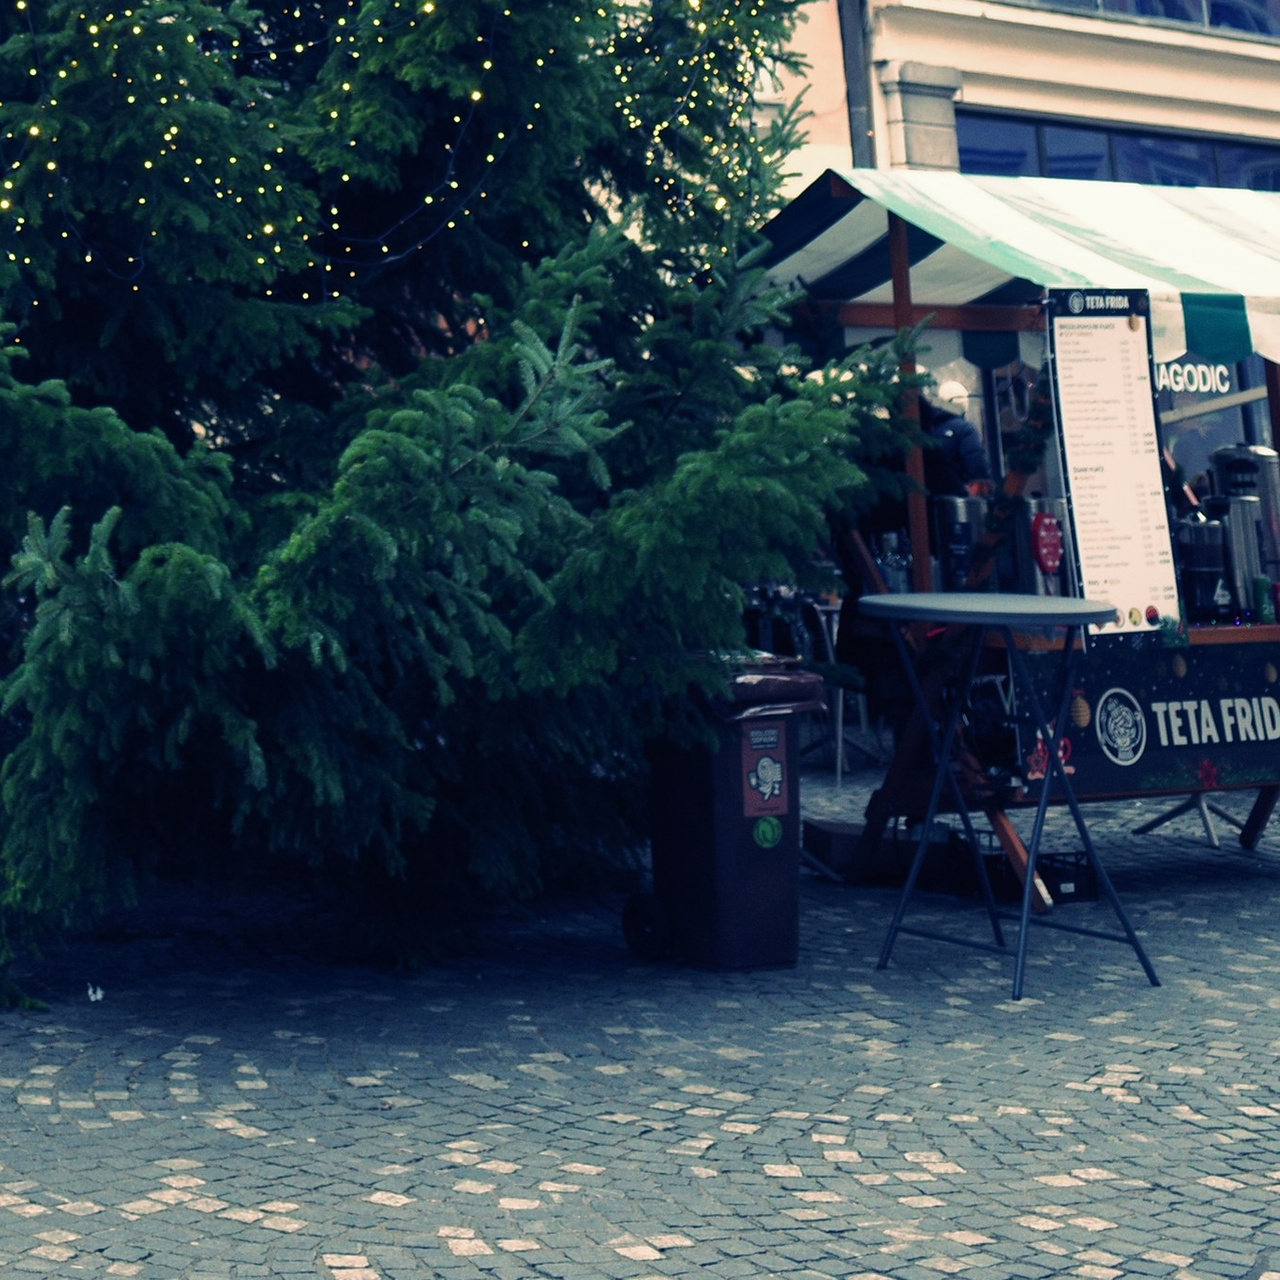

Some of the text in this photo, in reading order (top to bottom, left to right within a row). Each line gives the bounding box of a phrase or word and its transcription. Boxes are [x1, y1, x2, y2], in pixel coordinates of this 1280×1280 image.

[1084, 295, 1130, 310] TETA FRIDA
[1151, 700, 1220, 746] TETA
